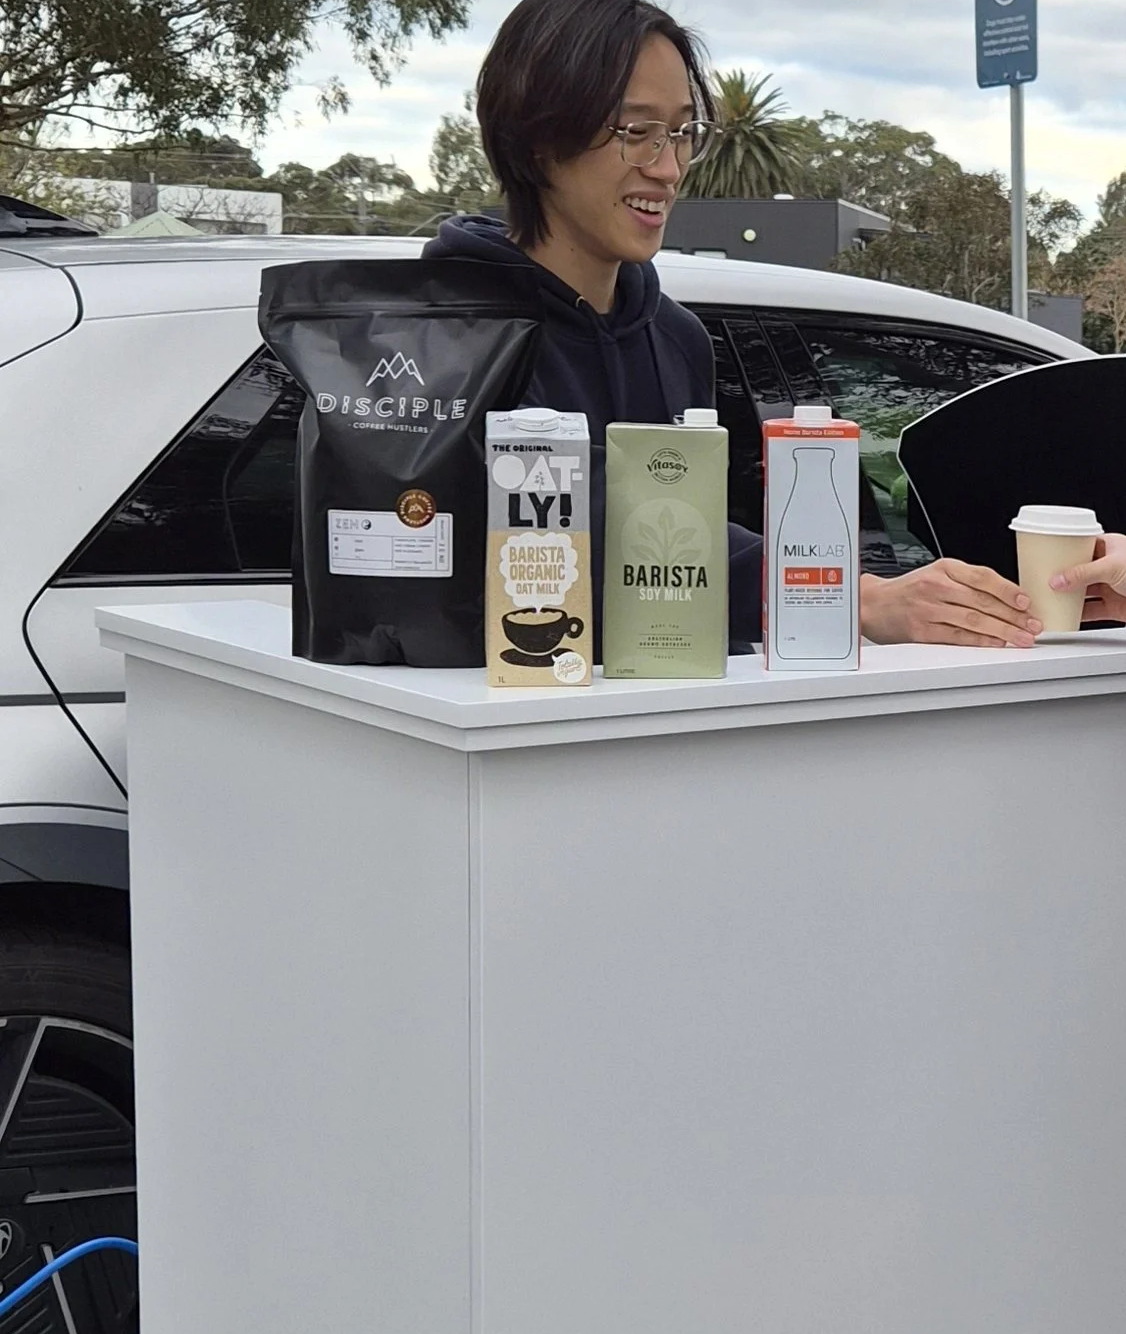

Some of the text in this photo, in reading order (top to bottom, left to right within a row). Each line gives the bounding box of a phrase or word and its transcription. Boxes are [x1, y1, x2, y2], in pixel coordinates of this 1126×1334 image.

[316, 393, 467, 421] DISCIPLE
[353, 422, 429, 434] COFFEE HUSTLERS
[492, 444, 554, 452] THE ORIGINAL
[647, 458, 688, 473] Vitasoy
[508, 493, 573, 528] LY!
[509, 545, 565, 563] BARISTA
[784, 544, 844, 557] MILKLAB
[509, 563, 565, 581] ORGANIC
[623, 565, 708, 588] BARISTA
[516, 583, 560, 595] OAT MILK
[639, 589, 692, 602] SOY MILK
